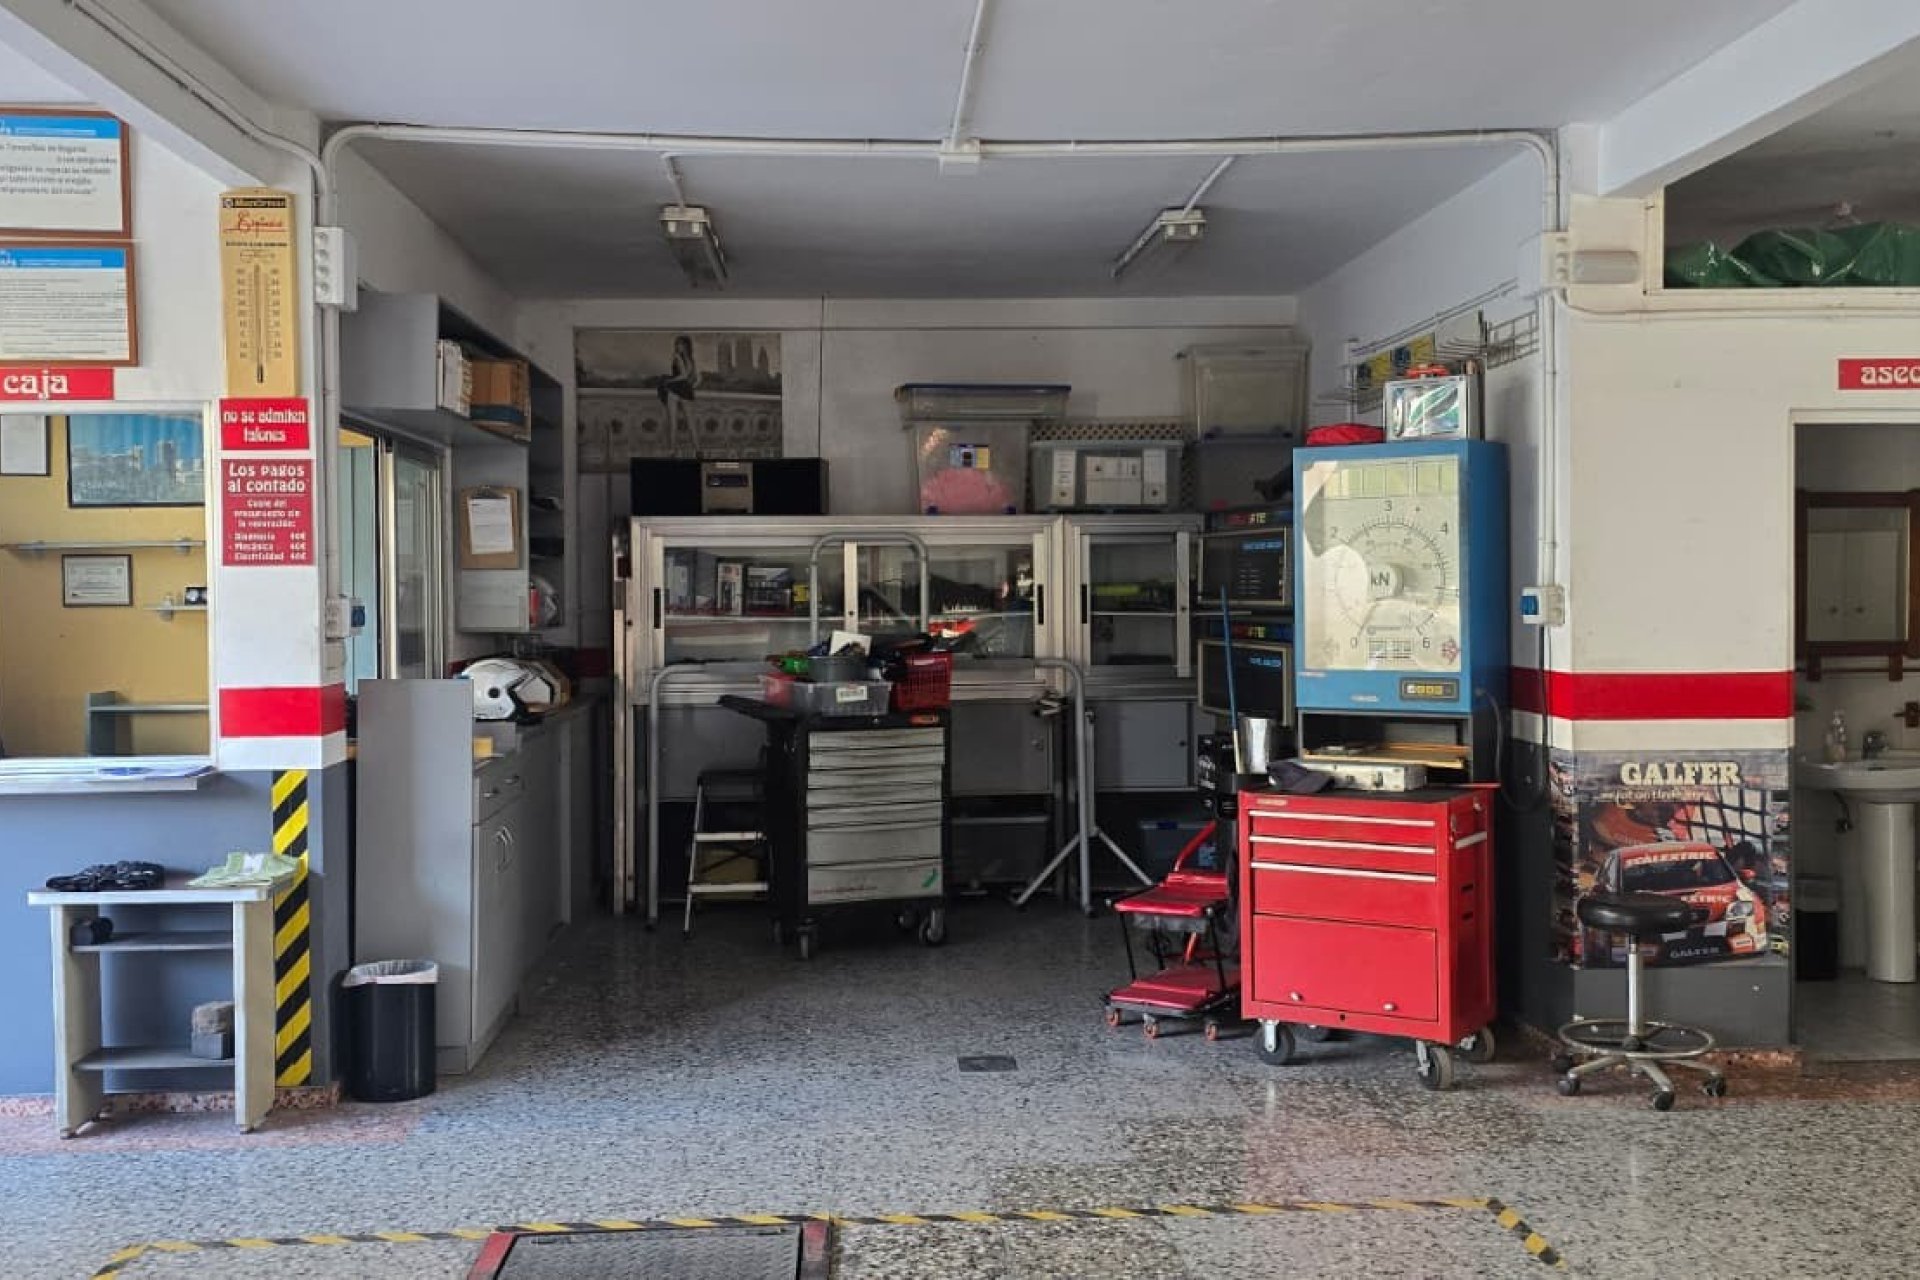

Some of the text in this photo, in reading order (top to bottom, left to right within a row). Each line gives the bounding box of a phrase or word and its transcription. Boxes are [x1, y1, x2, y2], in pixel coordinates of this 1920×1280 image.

[3, 369, 69, 399] caja
[223, 407, 305, 424] no se admiten
[243, 425, 287, 443] talones
[229, 462, 305, 478] Los pagos
[227, 478, 305, 493] al contado
[1383, 499, 1393, 512] 3
[1330, 526, 1339, 539] 2
[1436, 521, 1448, 535] 4
[1371, 569, 1390, 587] kN
[1351, 637, 1358, 649] 0
[1422, 636, 1431, 649] 6
[1620, 761, 1741, 786] GALFER
